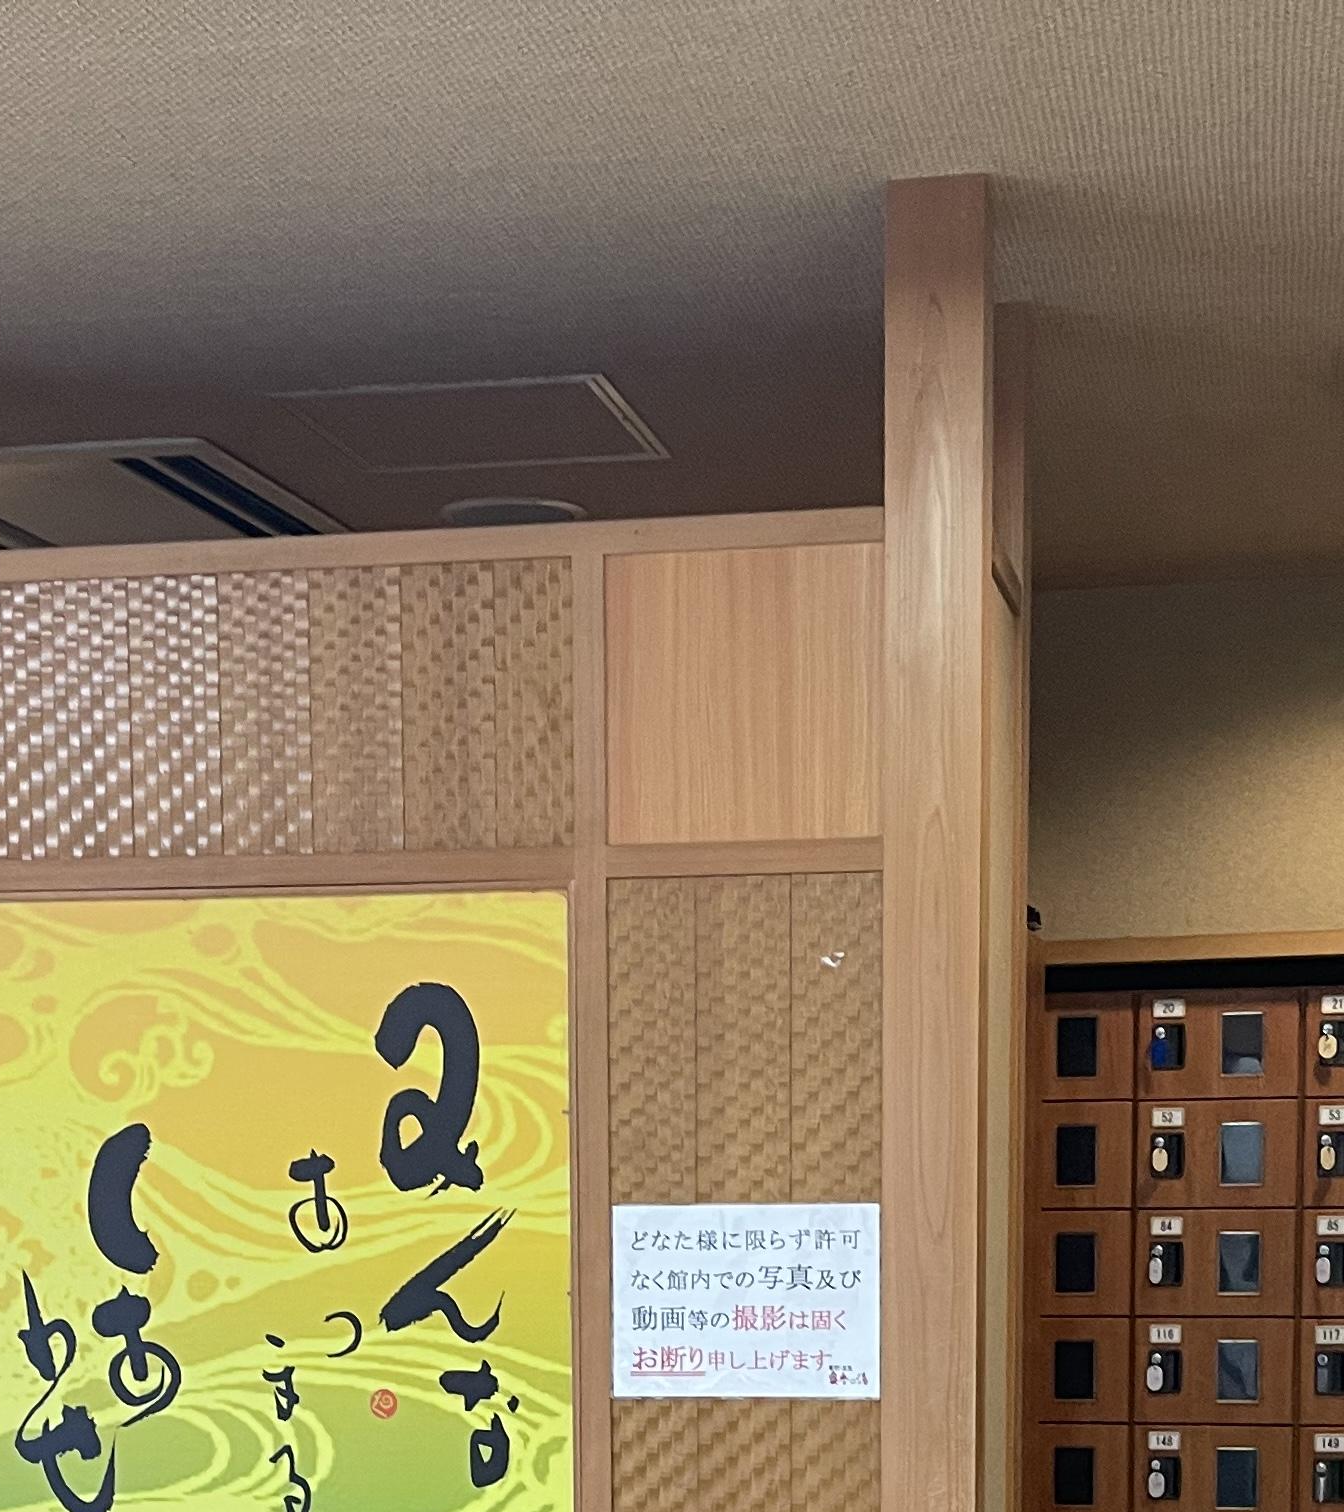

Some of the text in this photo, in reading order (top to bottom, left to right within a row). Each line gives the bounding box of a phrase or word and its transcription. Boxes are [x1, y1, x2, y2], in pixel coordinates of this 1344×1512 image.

[630, 1229, 861, 1251] どなた様に限らず許可
[630, 1264, 862, 1291] なく館内での写真及び
[631, 1304, 847, 1331] 動画等の撮影は固く
[631, 1346, 833, 1371] お断り申し上げます
